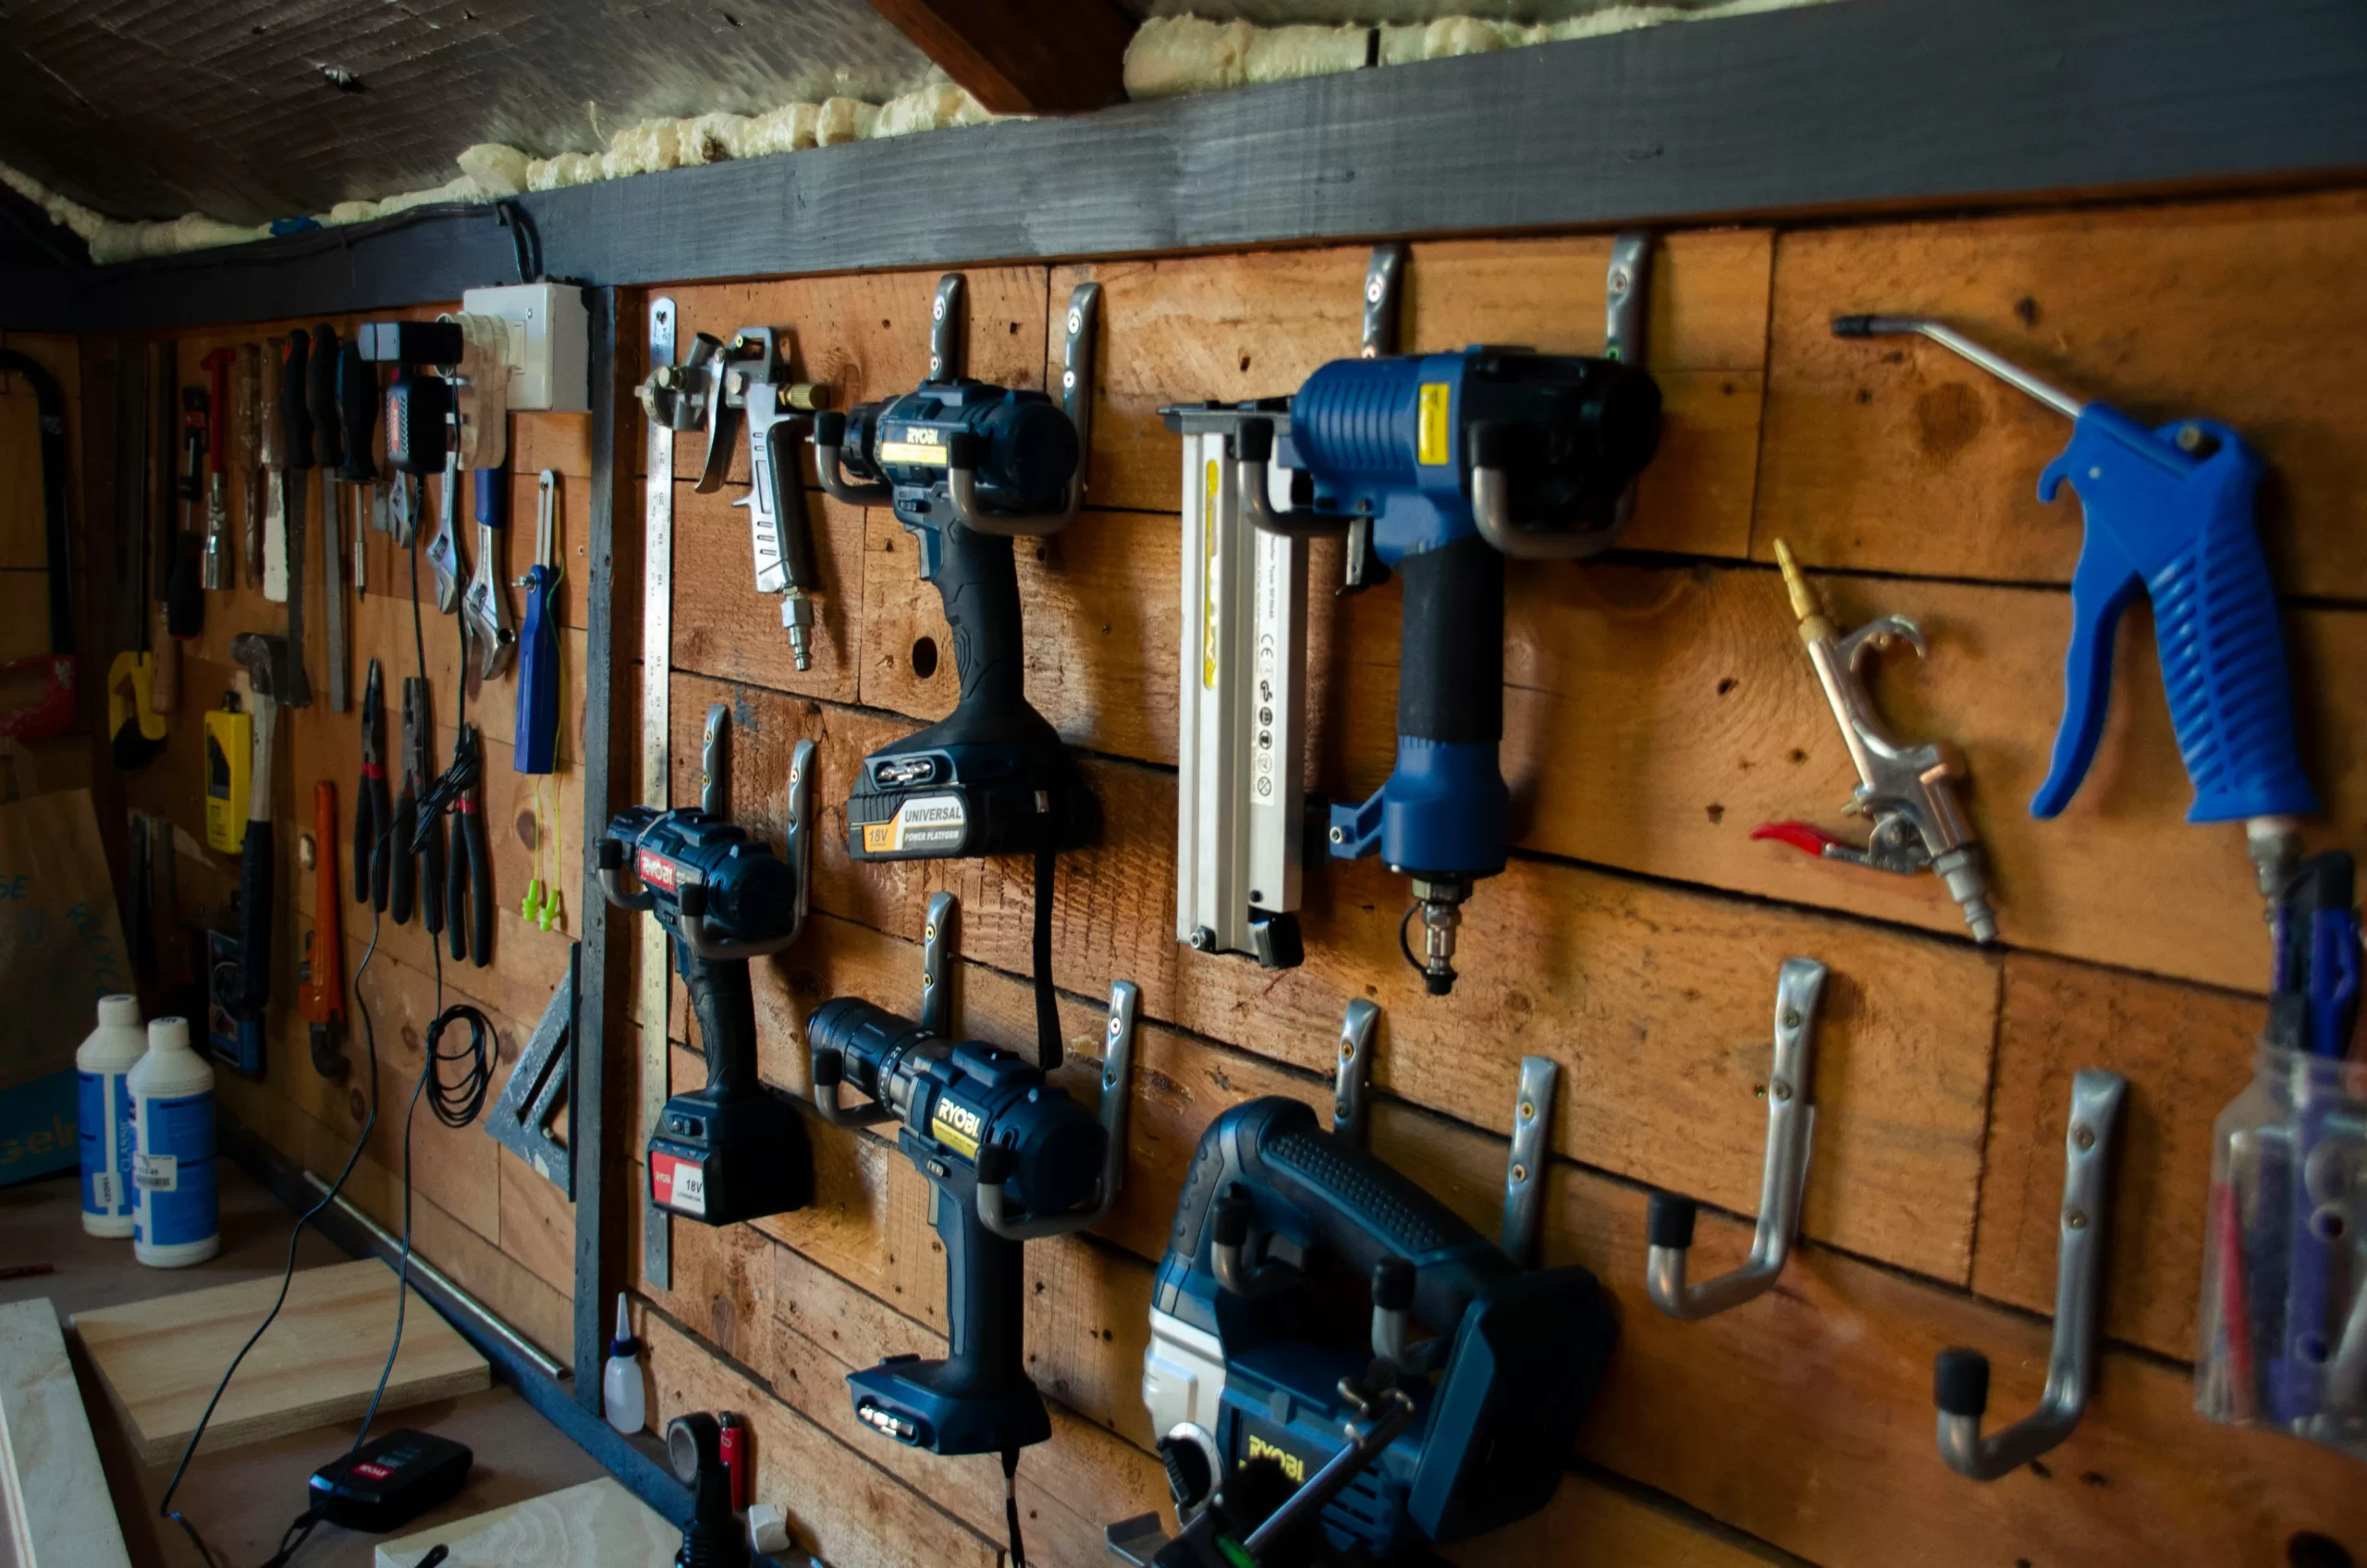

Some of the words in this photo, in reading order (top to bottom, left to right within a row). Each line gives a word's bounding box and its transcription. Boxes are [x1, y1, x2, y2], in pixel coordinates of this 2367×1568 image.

[661, 326, 668, 340] 24
[906, 426, 938, 445] RYOBI
[659, 452, 666, 464] 21
[658, 492, 665, 506] 20
[657, 533, 664, 545] 19
[656, 574, 663, 586] 18
[1260, 633, 1274, 658] CE
[656, 655, 662, 667] 16
[656, 736, 661, 748] 14
[905, 806, 962, 823] UNIVERSAL
[869, 827, 888, 842] 18V
[905, 832, 926, 842] POWER
[927, 830, 960, 840] PLATFORM
[890, 1046, 902, 1060] 21
[938, 1096, 980, 1138] RYOBI
[686, 1179, 704, 1194] 18V
